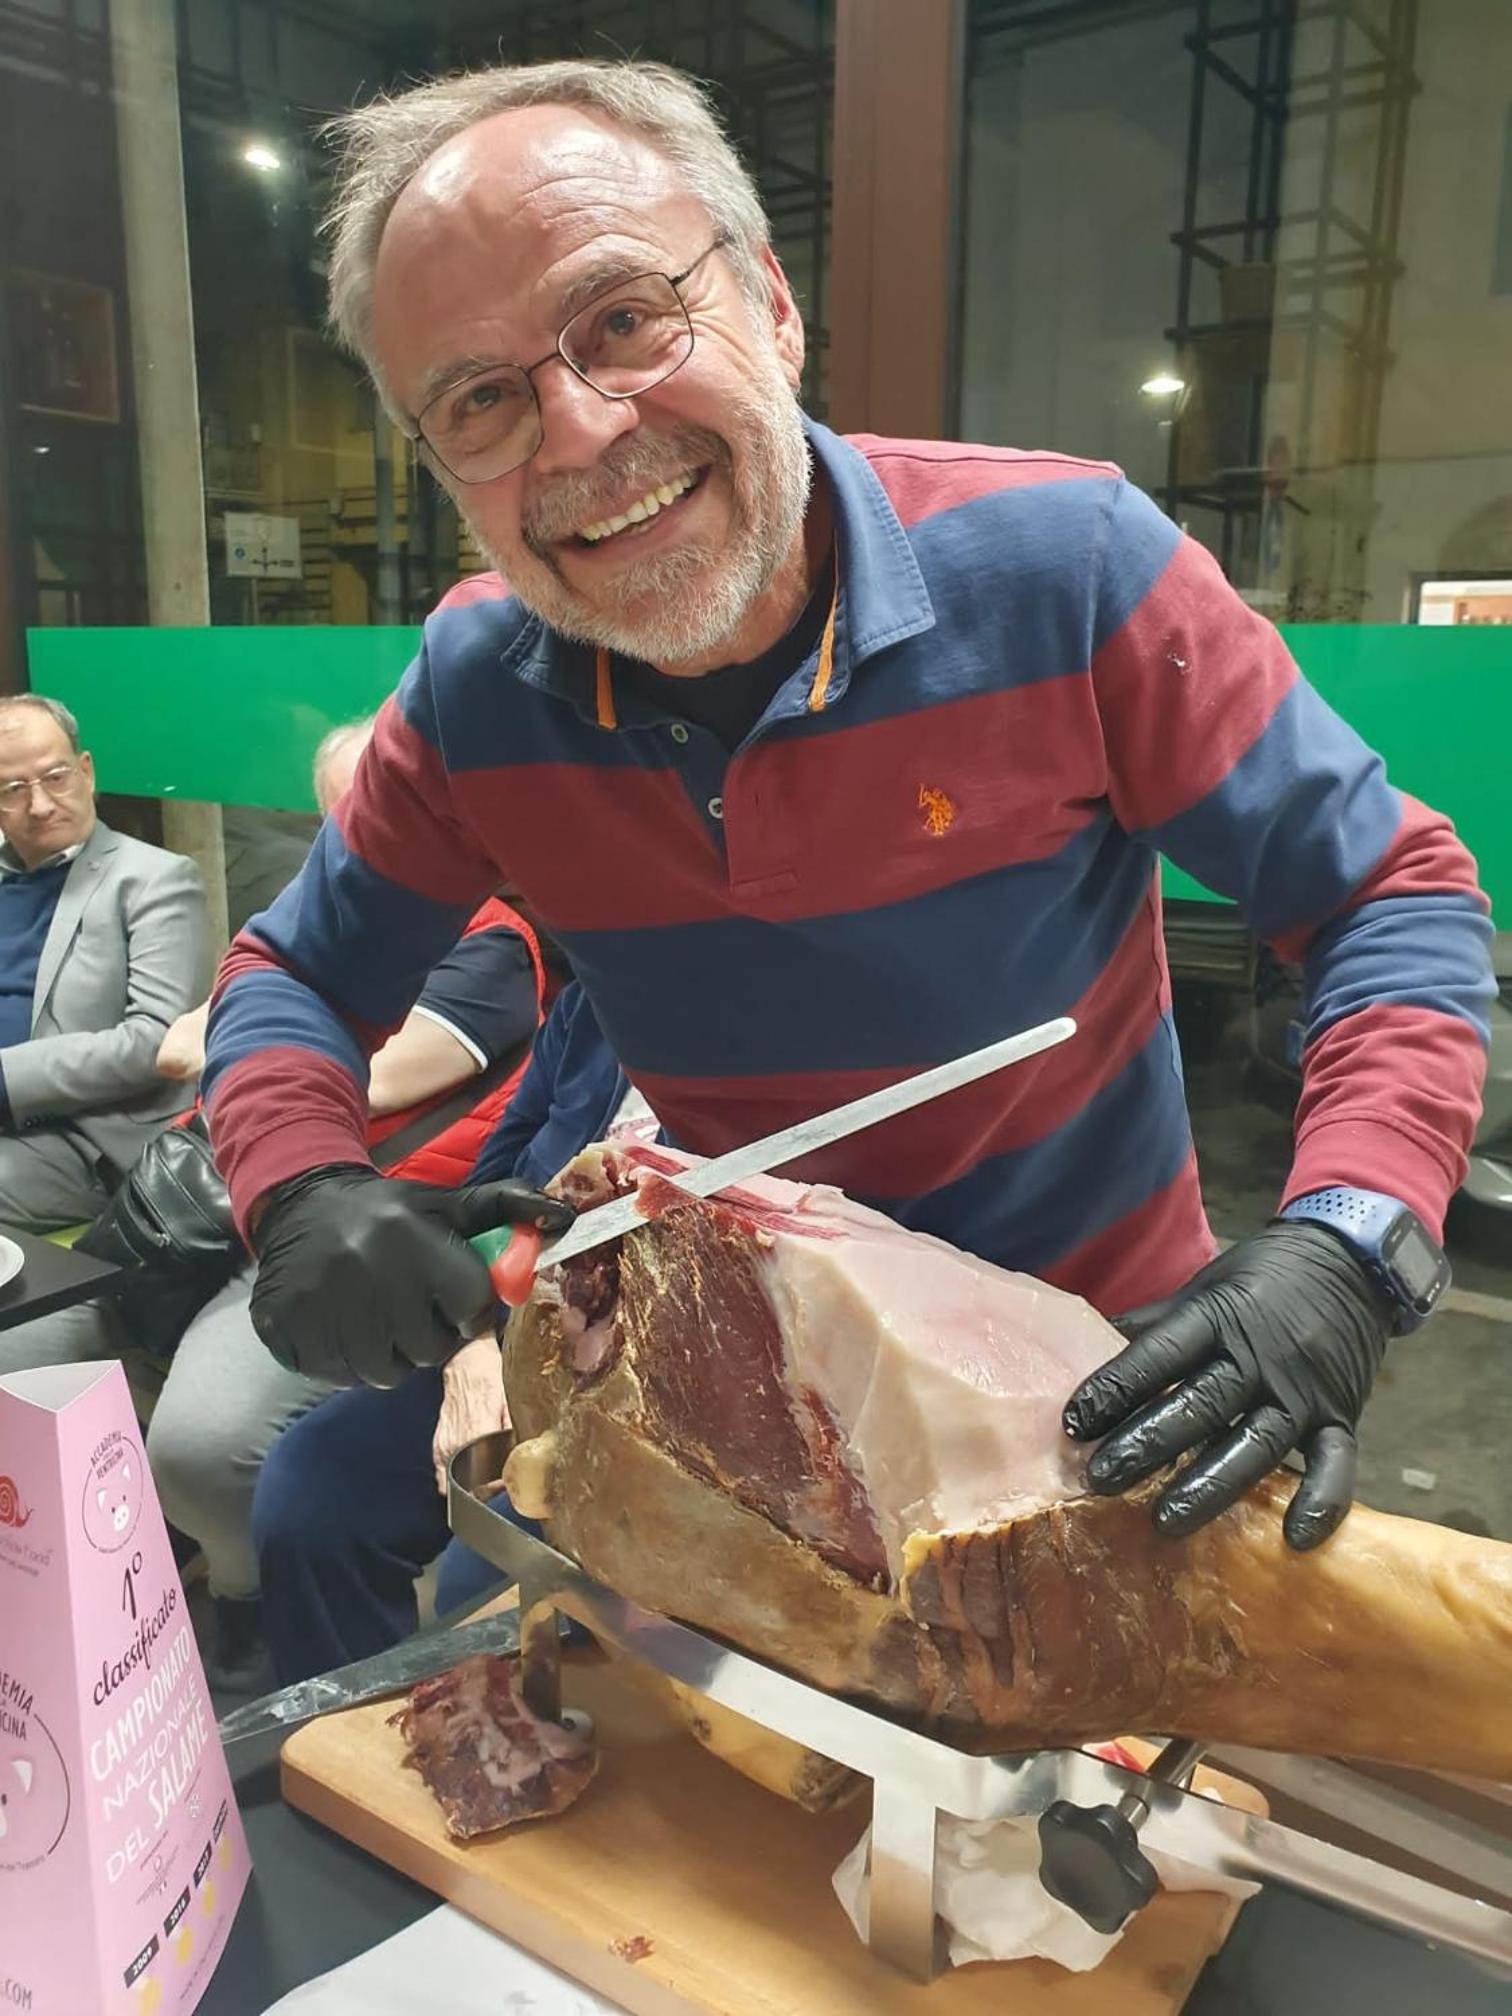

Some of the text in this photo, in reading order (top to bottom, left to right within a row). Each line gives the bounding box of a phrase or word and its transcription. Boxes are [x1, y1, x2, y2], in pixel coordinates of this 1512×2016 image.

[0, 1671, 33, 1716] EMIA
[90, 1625, 191, 1782] CAMPIONATO
[93, 1588, 177, 1706] classificato
[0, 1711, 27, 1741] CINA
[102, 1674, 198, 1823] NAZIONALE
[105, 1826, 150, 1885] DEL
[148, 1698, 209, 1830] SALAME
